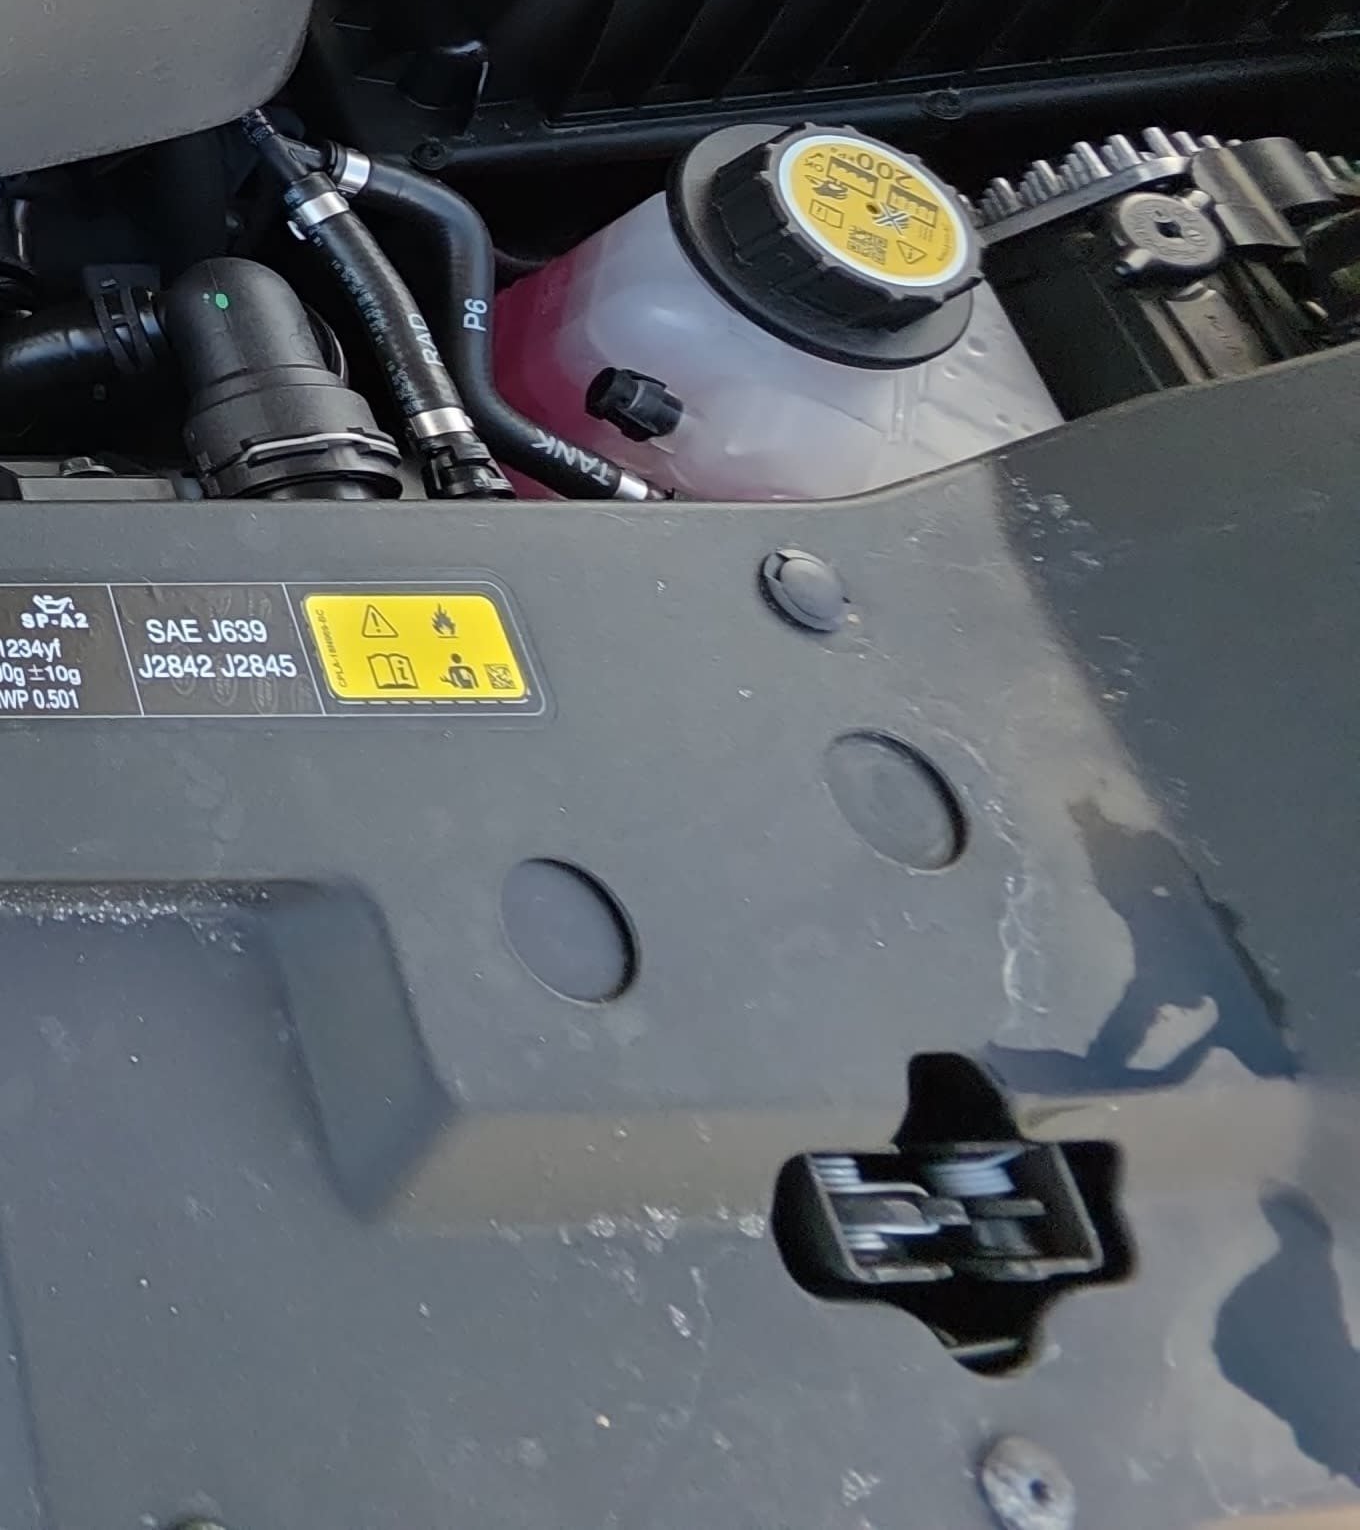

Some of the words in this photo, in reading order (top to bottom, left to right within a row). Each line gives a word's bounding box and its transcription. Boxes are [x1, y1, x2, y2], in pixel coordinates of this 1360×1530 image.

[857, 153, 914, 189] 200
[463, 298, 488, 331] P6
[407, 313, 444, 366] RAD
[530, 428, 610, 486] TANK
[20, 613, 89, 629] SP-A2
[145, 618, 202, 643] SAE
[207, 618, 267, 644] J639
[138, 654, 216, 679] J2842
[221, 653, 297, 678] J2845
[33, 689, 79, 709] 0.501
